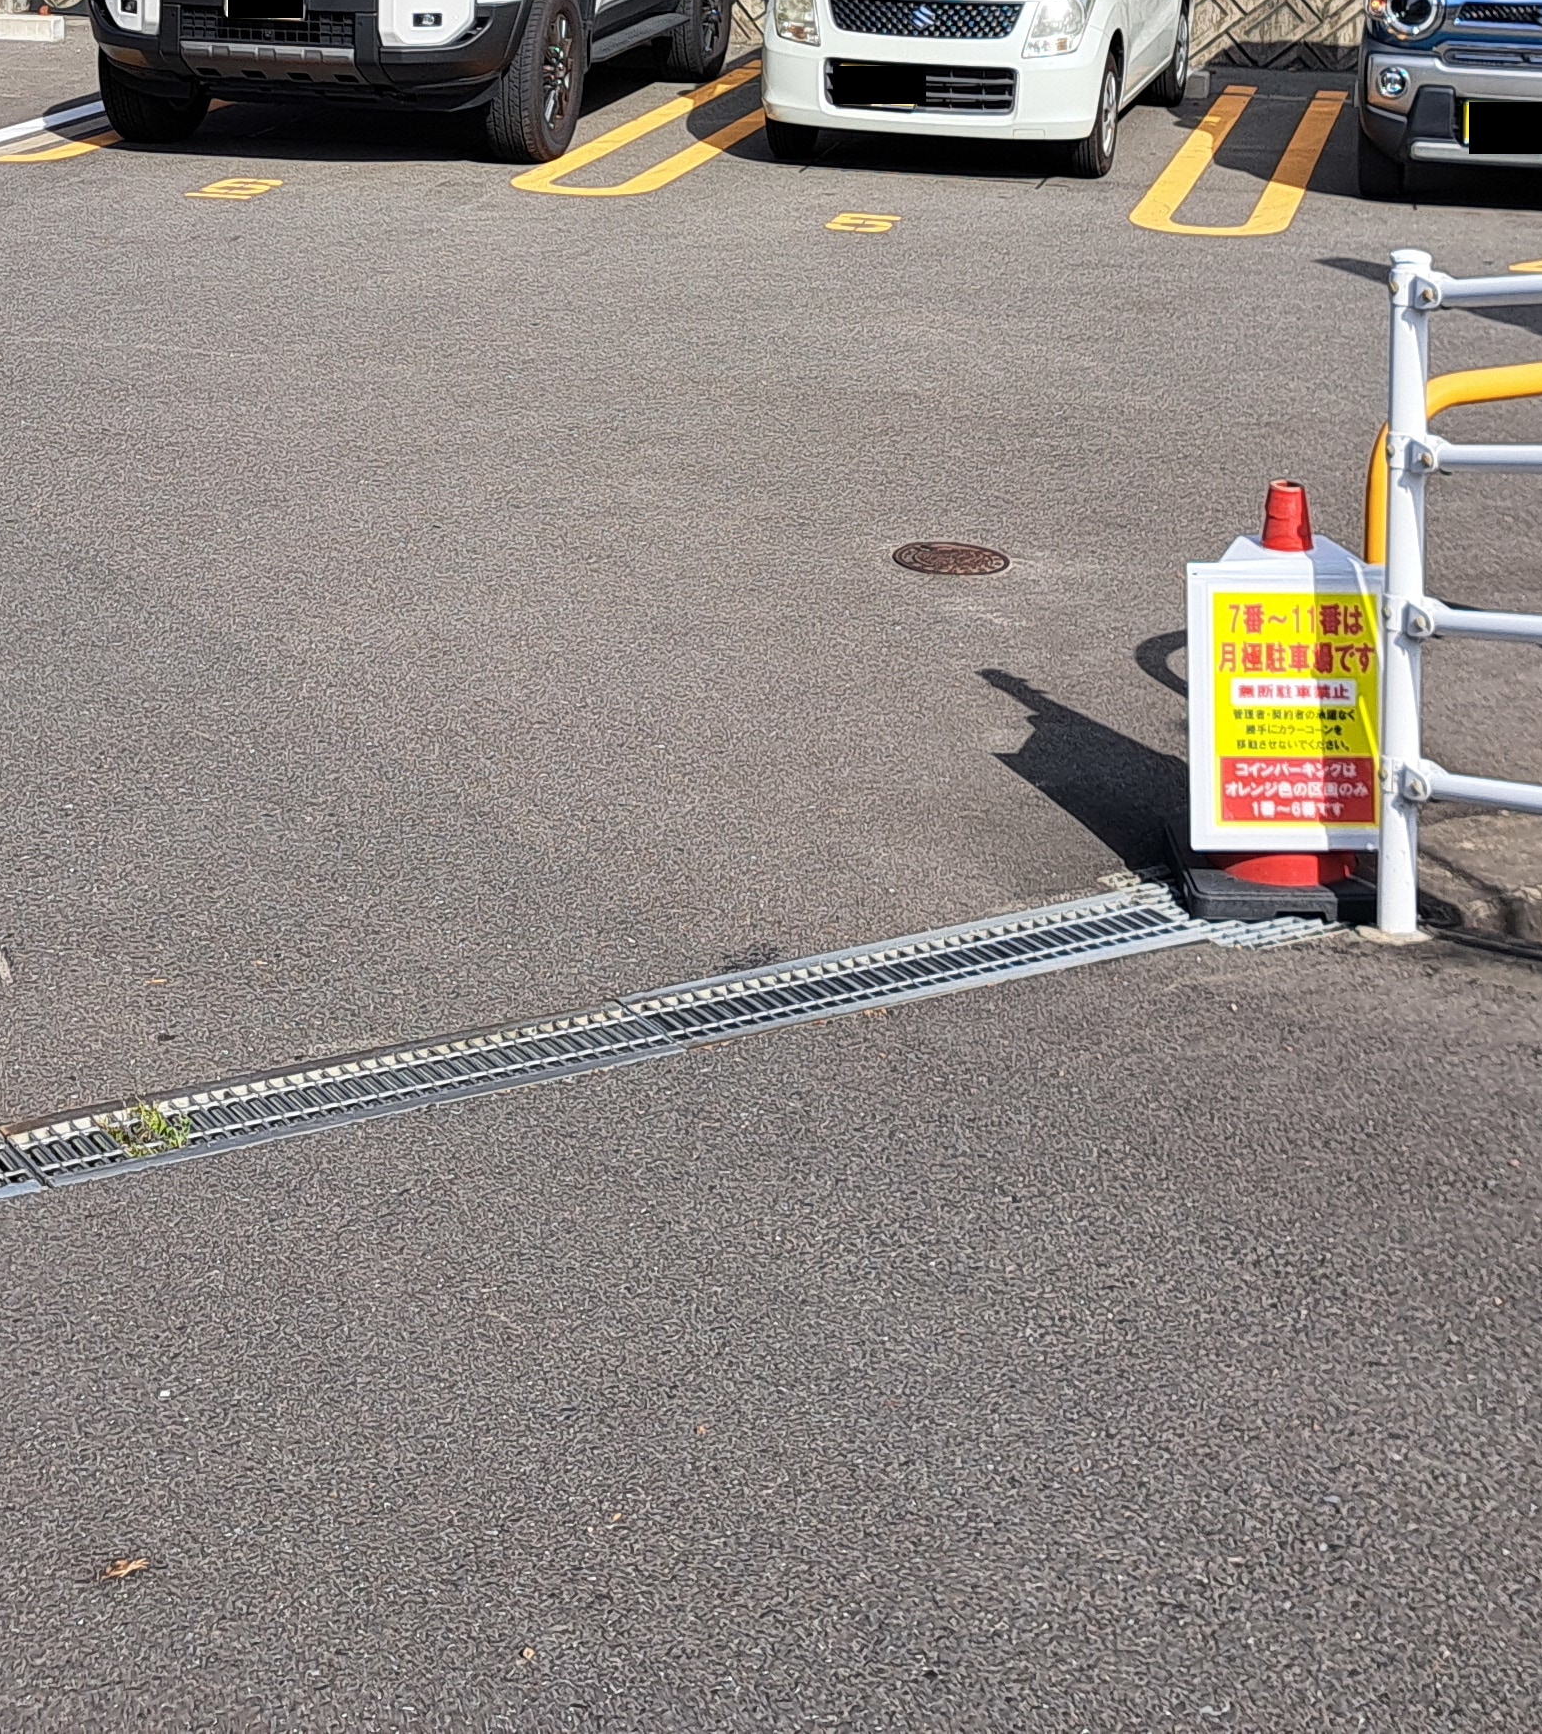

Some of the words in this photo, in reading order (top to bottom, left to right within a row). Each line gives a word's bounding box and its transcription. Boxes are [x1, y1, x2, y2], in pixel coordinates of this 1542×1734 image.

[825, 213, 903, 233] 5
[1219, 642, 1375, 674] 月極駐車場です
[1238, 684, 1350, 701] 無断駐車禁止
[1245, 724, 1343, 736] 勝手にカラーコーンを
[1236, 739, 1350, 752] 移動させないでください。
[1235, 762, 1358, 778] コインパーキングは
[1225, 781, 1369, 798] オレンジ色の区画のみ
